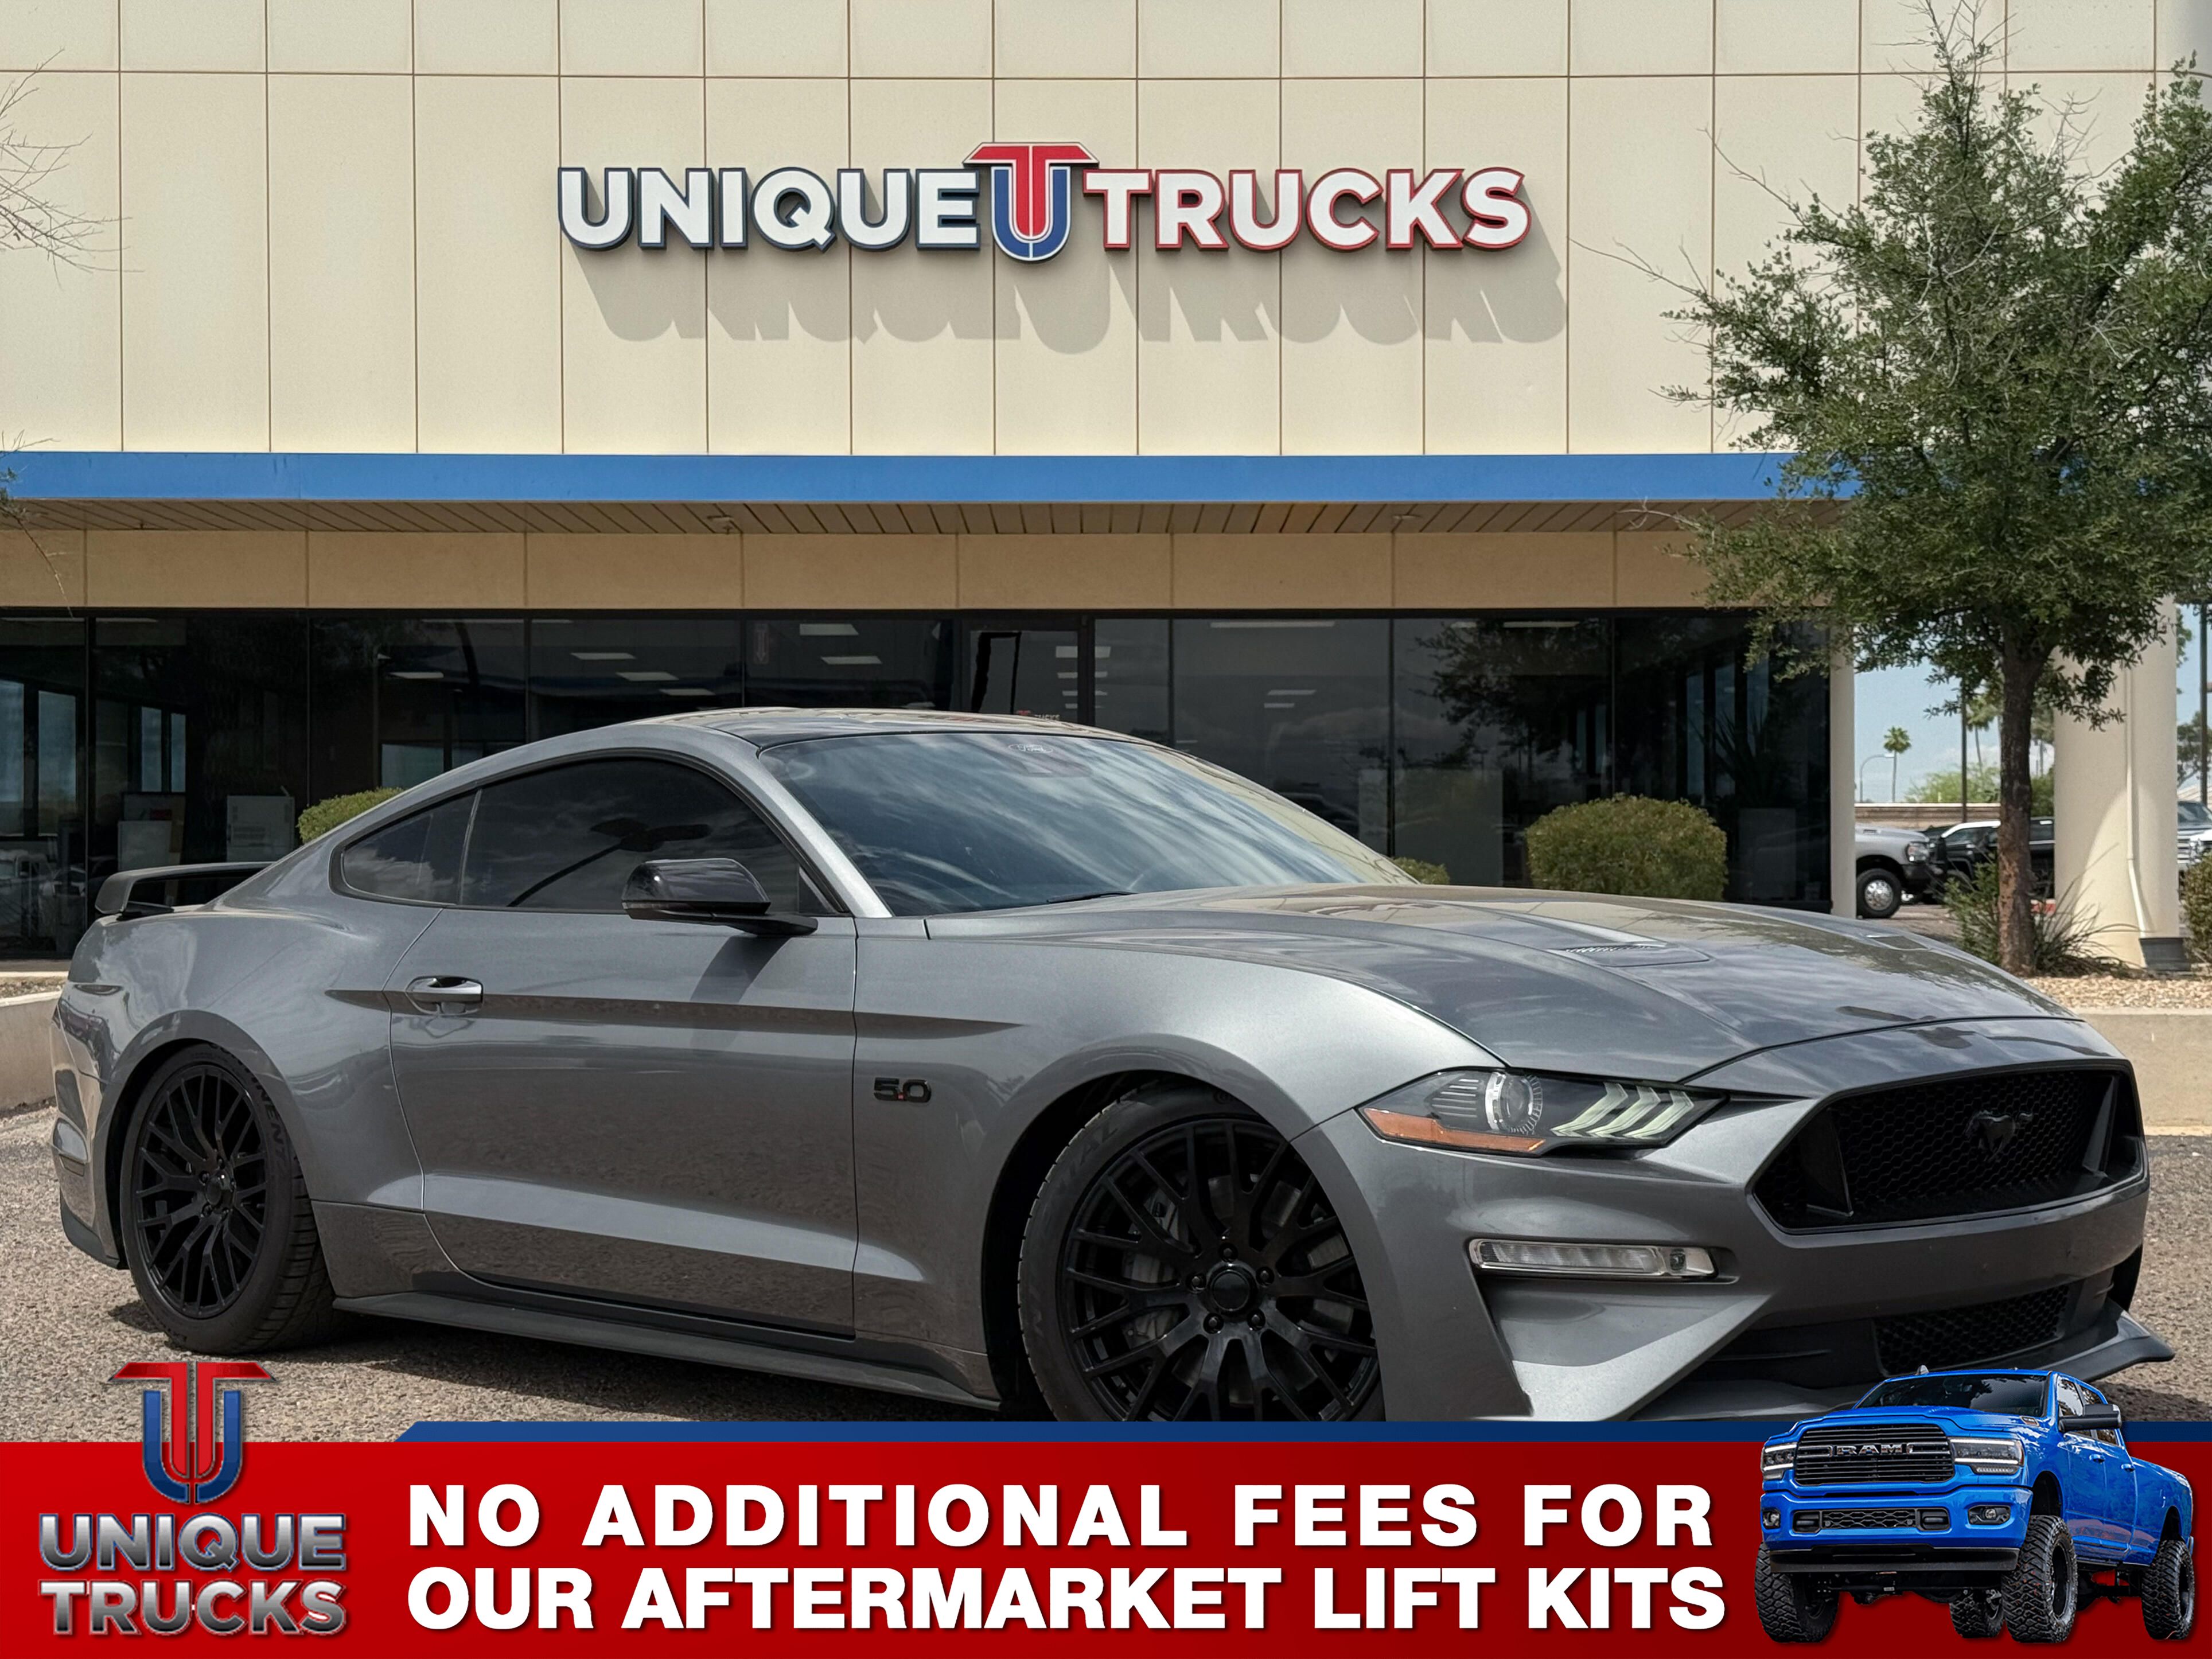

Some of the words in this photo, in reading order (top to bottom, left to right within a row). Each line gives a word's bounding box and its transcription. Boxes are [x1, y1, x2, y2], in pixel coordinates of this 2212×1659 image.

[558, 166, 980, 252] UNIQUE
[1082, 166, 1532, 251] TRUCKS
[873, 1077, 932, 1103] 5.0
